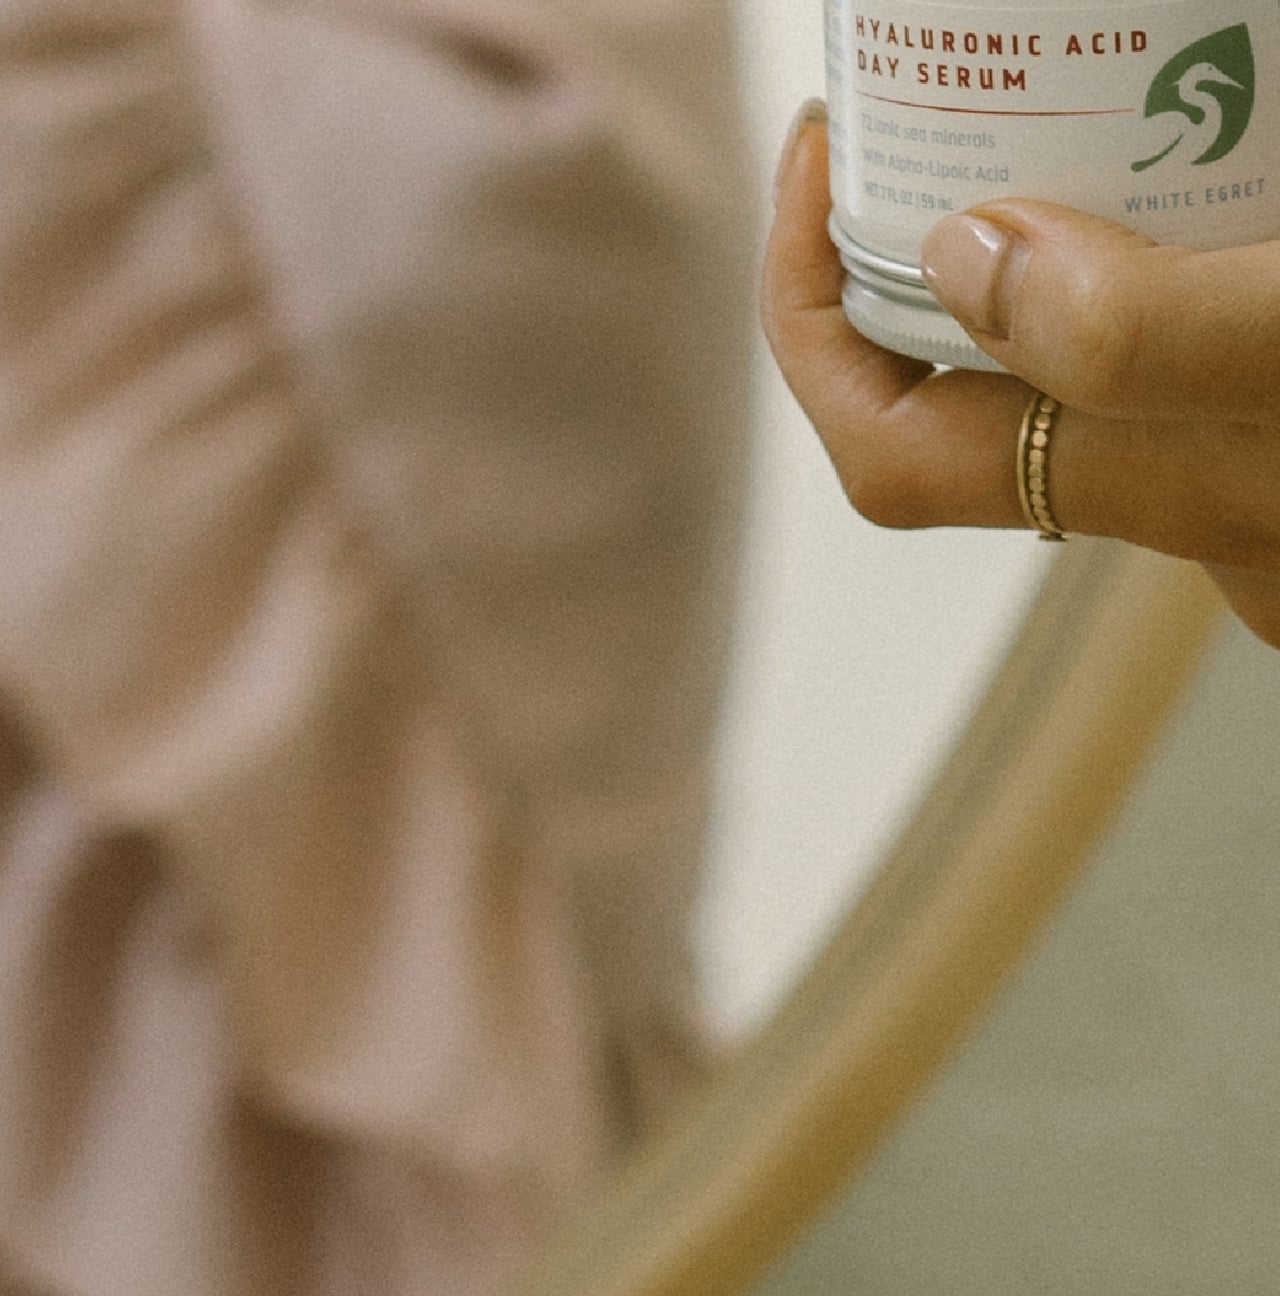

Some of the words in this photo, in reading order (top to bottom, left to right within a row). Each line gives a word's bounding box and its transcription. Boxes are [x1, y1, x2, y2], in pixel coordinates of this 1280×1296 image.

[856, 15, 1041, 56] HYALURONIC
[1065, 31, 1147, 55] ACID
[858, 49, 899, 78] DAY
[918, 63, 1026, 91] SERUM
[904, 127, 927, 142] sea
[931, 129, 996, 149] minerals
[888, 154, 971, 180] Alpha-Lipoic
[975, 165, 1009, 182] Acid
[1124, 191, 1195, 212] WHITE
[1205, 178, 1265, 203] EGRET
